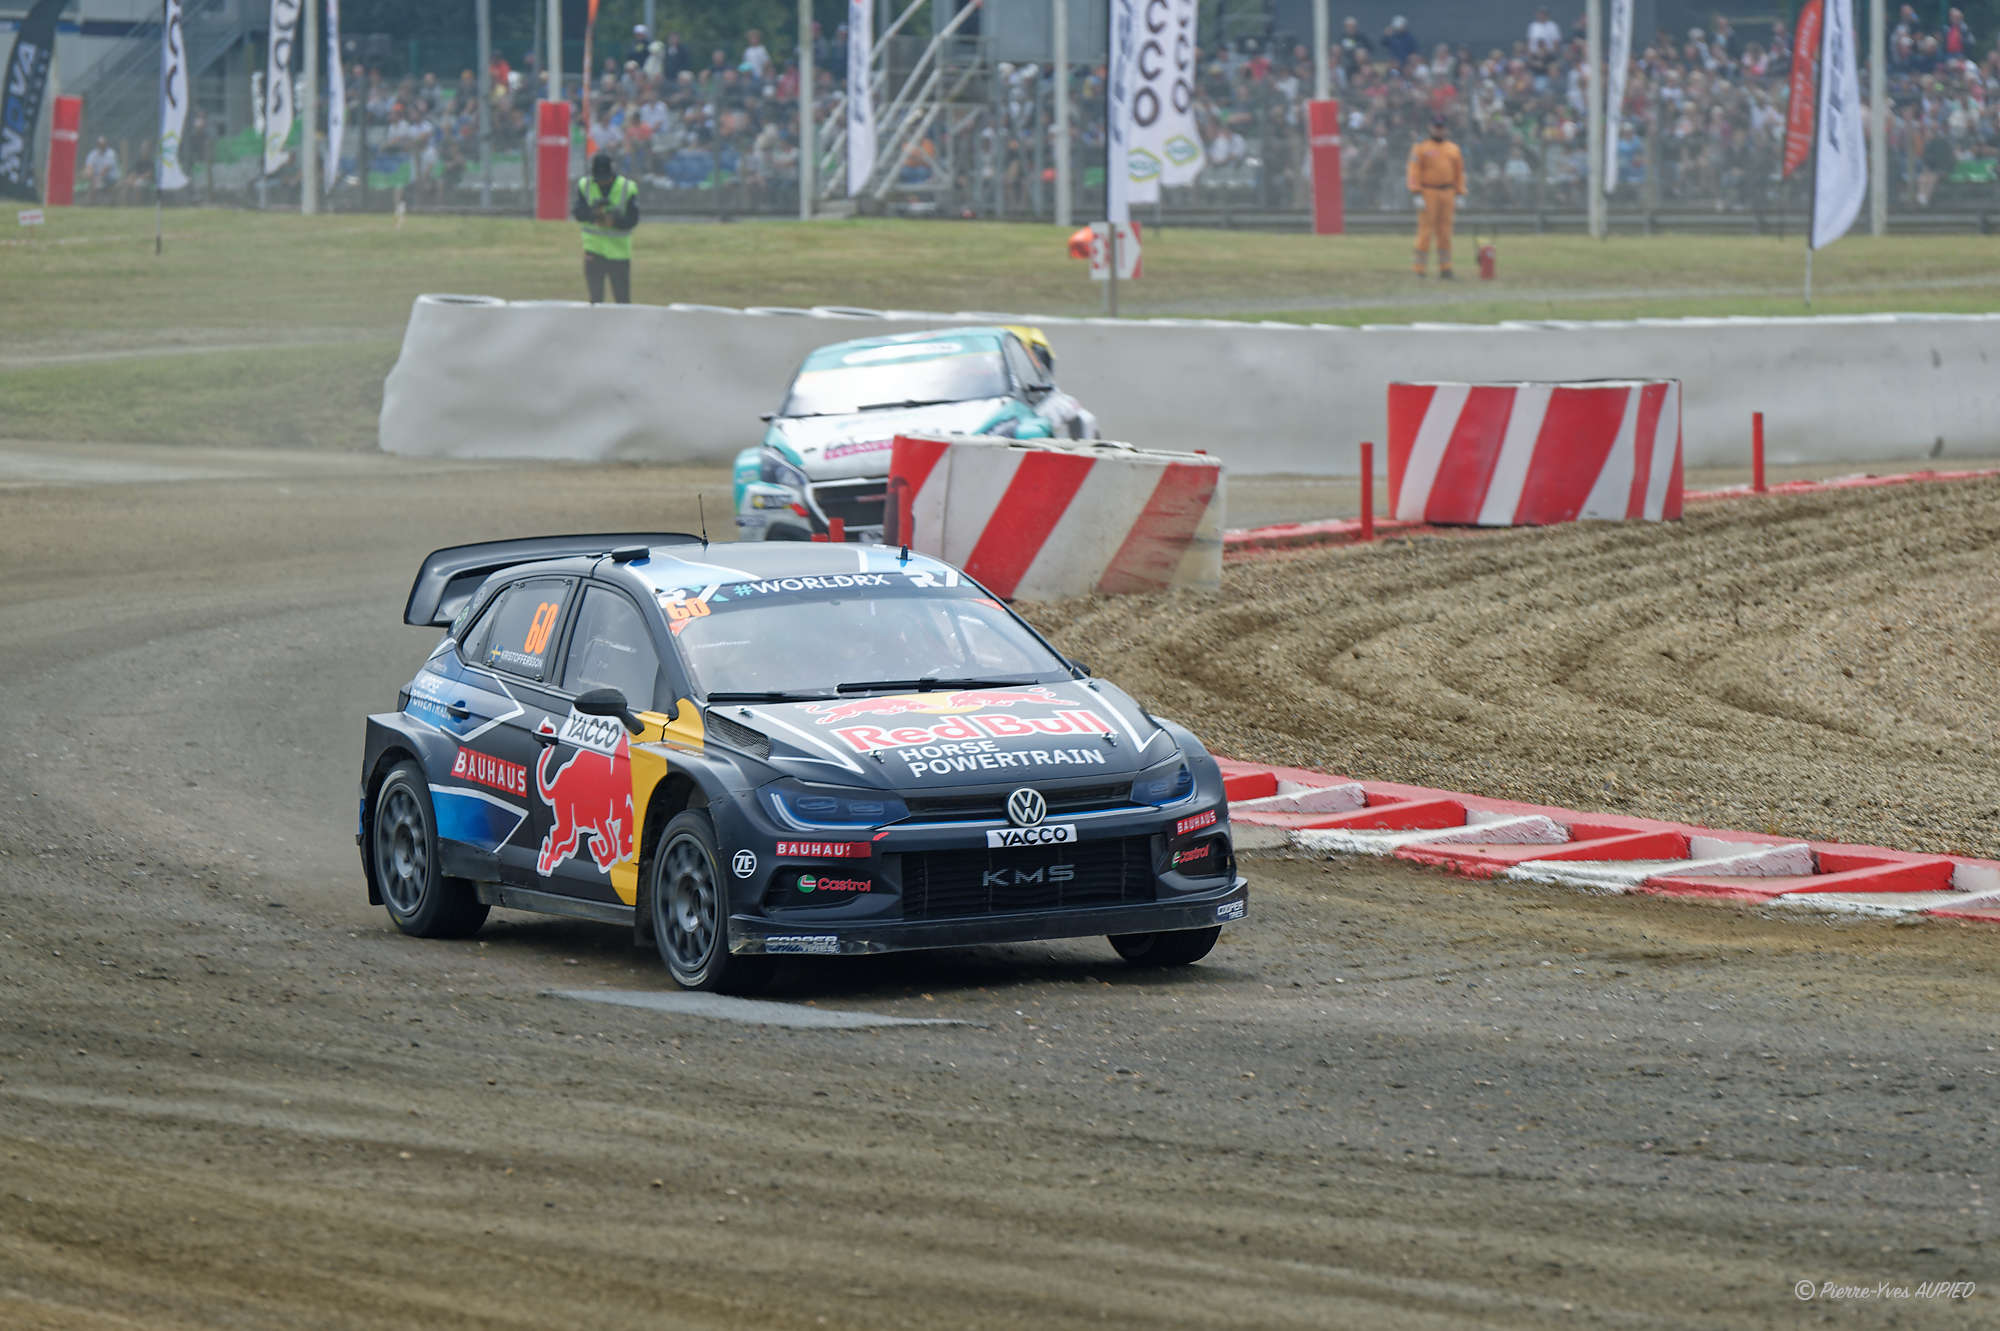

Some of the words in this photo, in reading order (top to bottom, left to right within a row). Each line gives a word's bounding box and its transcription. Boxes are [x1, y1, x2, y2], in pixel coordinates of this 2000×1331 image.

[733, 573, 890, 597] #WORLDRX
[666, 597, 712, 620] 60
[524, 602, 559, 655] 60
[567, 714, 620, 748] YACCO
[830, 715, 988, 753] Red
[966, 709, 1118, 738] Bull
[897, 740, 1000, 763] HORSE
[907, 748, 1106, 778] POWERTRAIN
[454, 751, 526, 792] BAUHAUS
[1177, 810, 1217, 833] BAUHAUS
[999, 827, 1067, 846] YACCO
[817, 877, 871, 893] Castrol
[982, 864, 1076, 887] KMS
